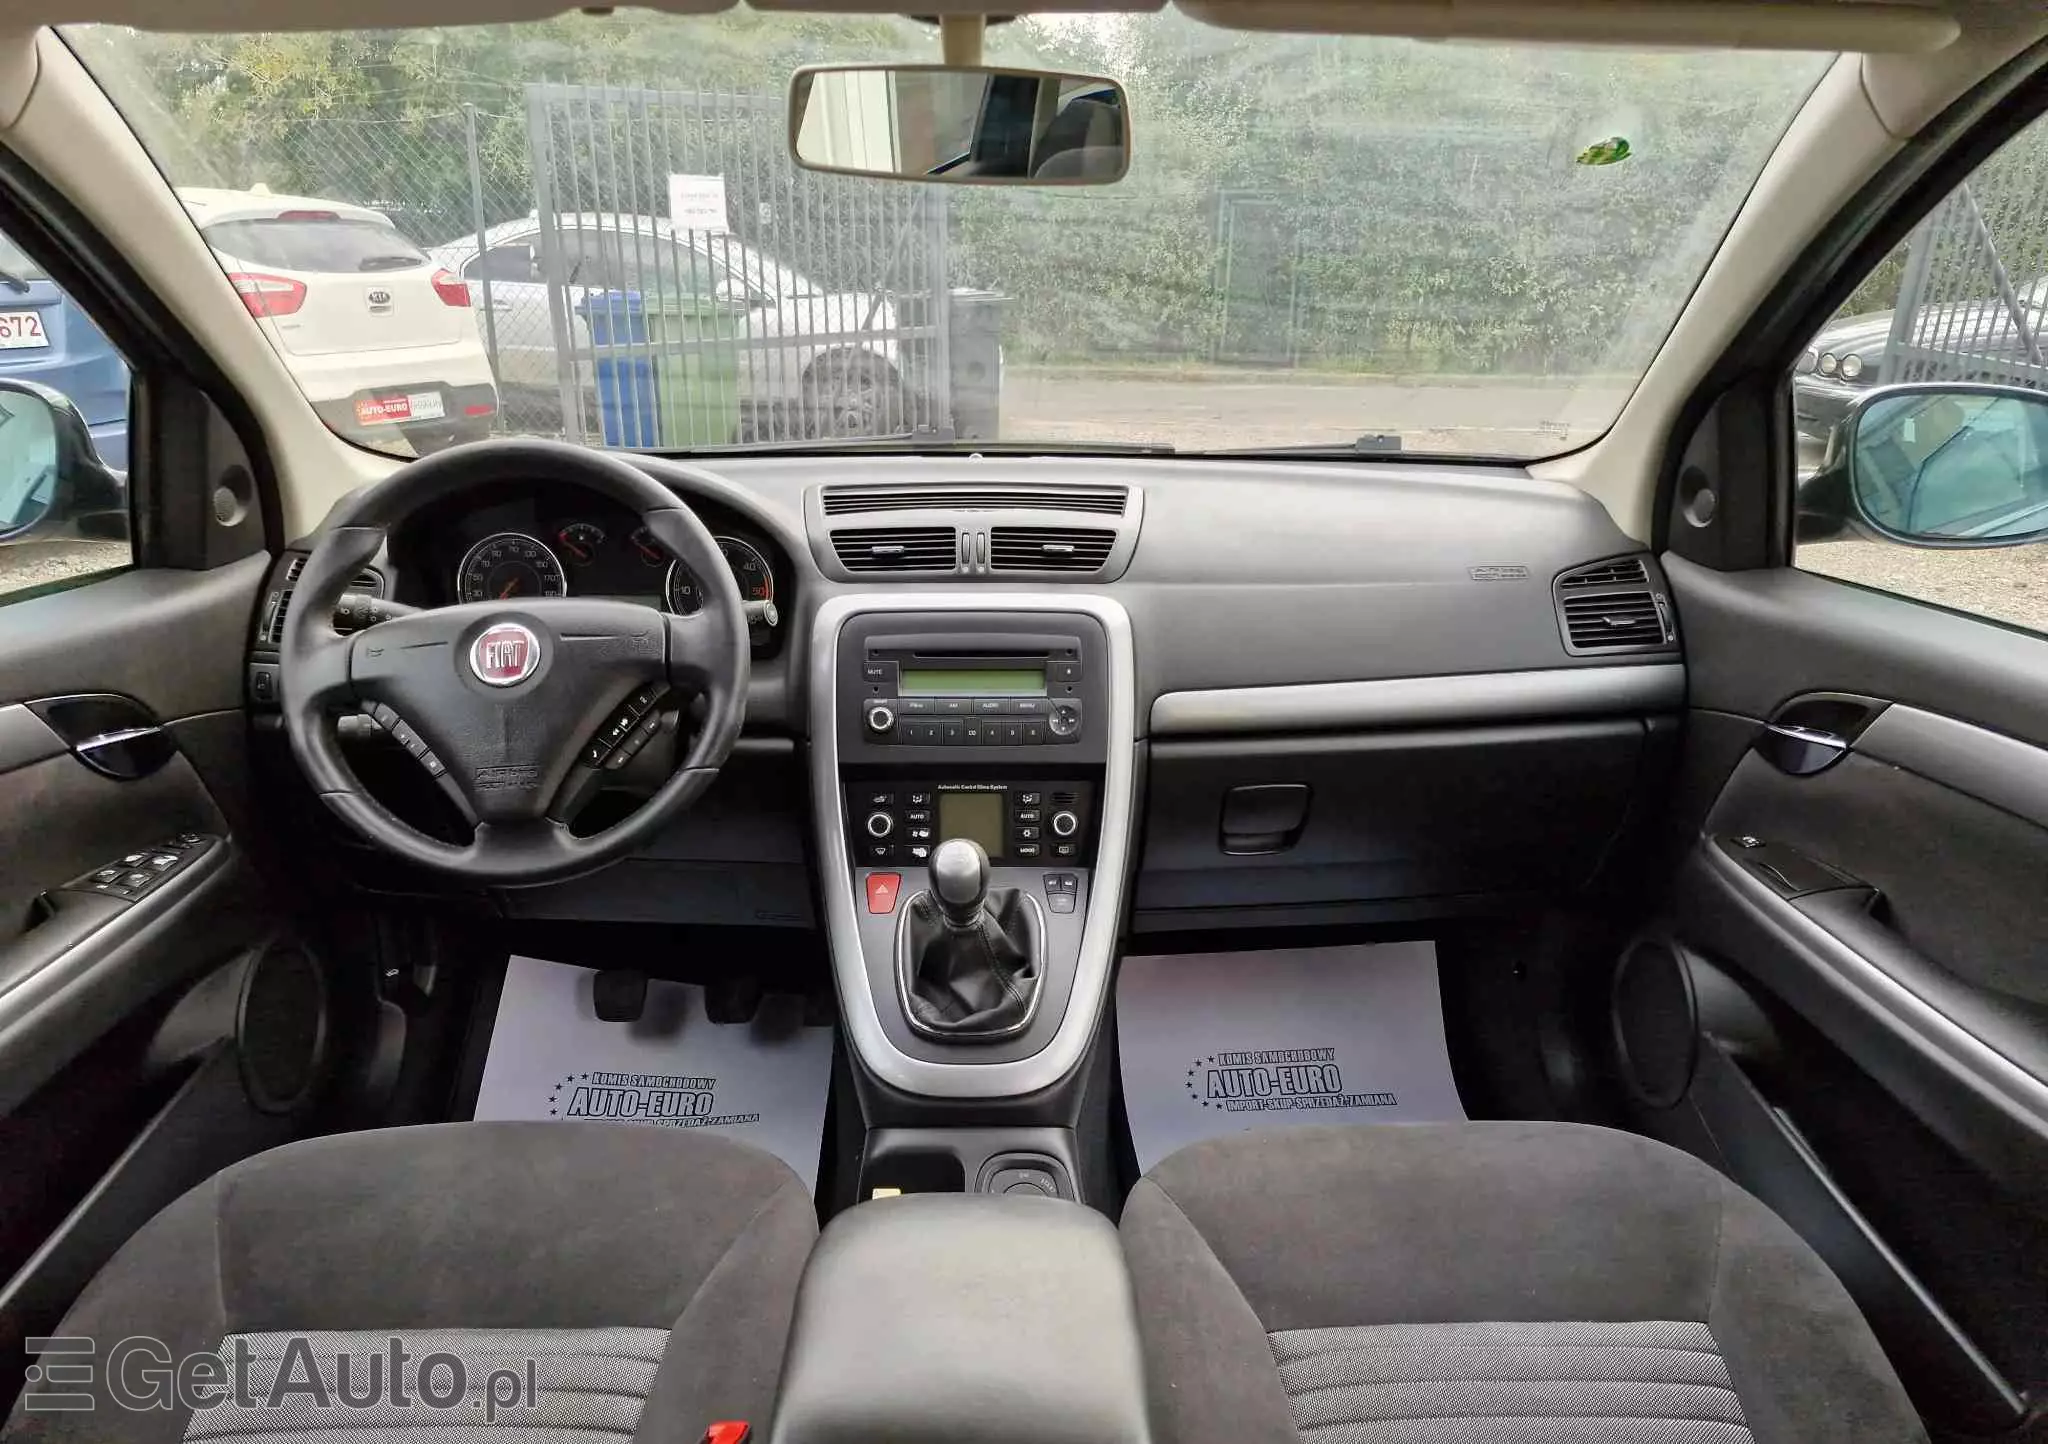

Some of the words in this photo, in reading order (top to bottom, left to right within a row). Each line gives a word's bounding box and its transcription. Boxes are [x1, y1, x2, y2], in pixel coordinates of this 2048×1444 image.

[0, 316, 41, 338] 672
[486, 639, 525, 668] FIAT
[1217, 1053, 1253, 1067] KOMIS
[1254, 1048, 1335, 1064] SAMOCHODOWY
[592, 1072, 629, 1085] KOMIS
[630, 1074, 716, 1089] SAMOCHODOWY
[1207, 1064, 1343, 1098] AUTO-EURO
[567, 1087, 714, 1117] AUTO-EURO
